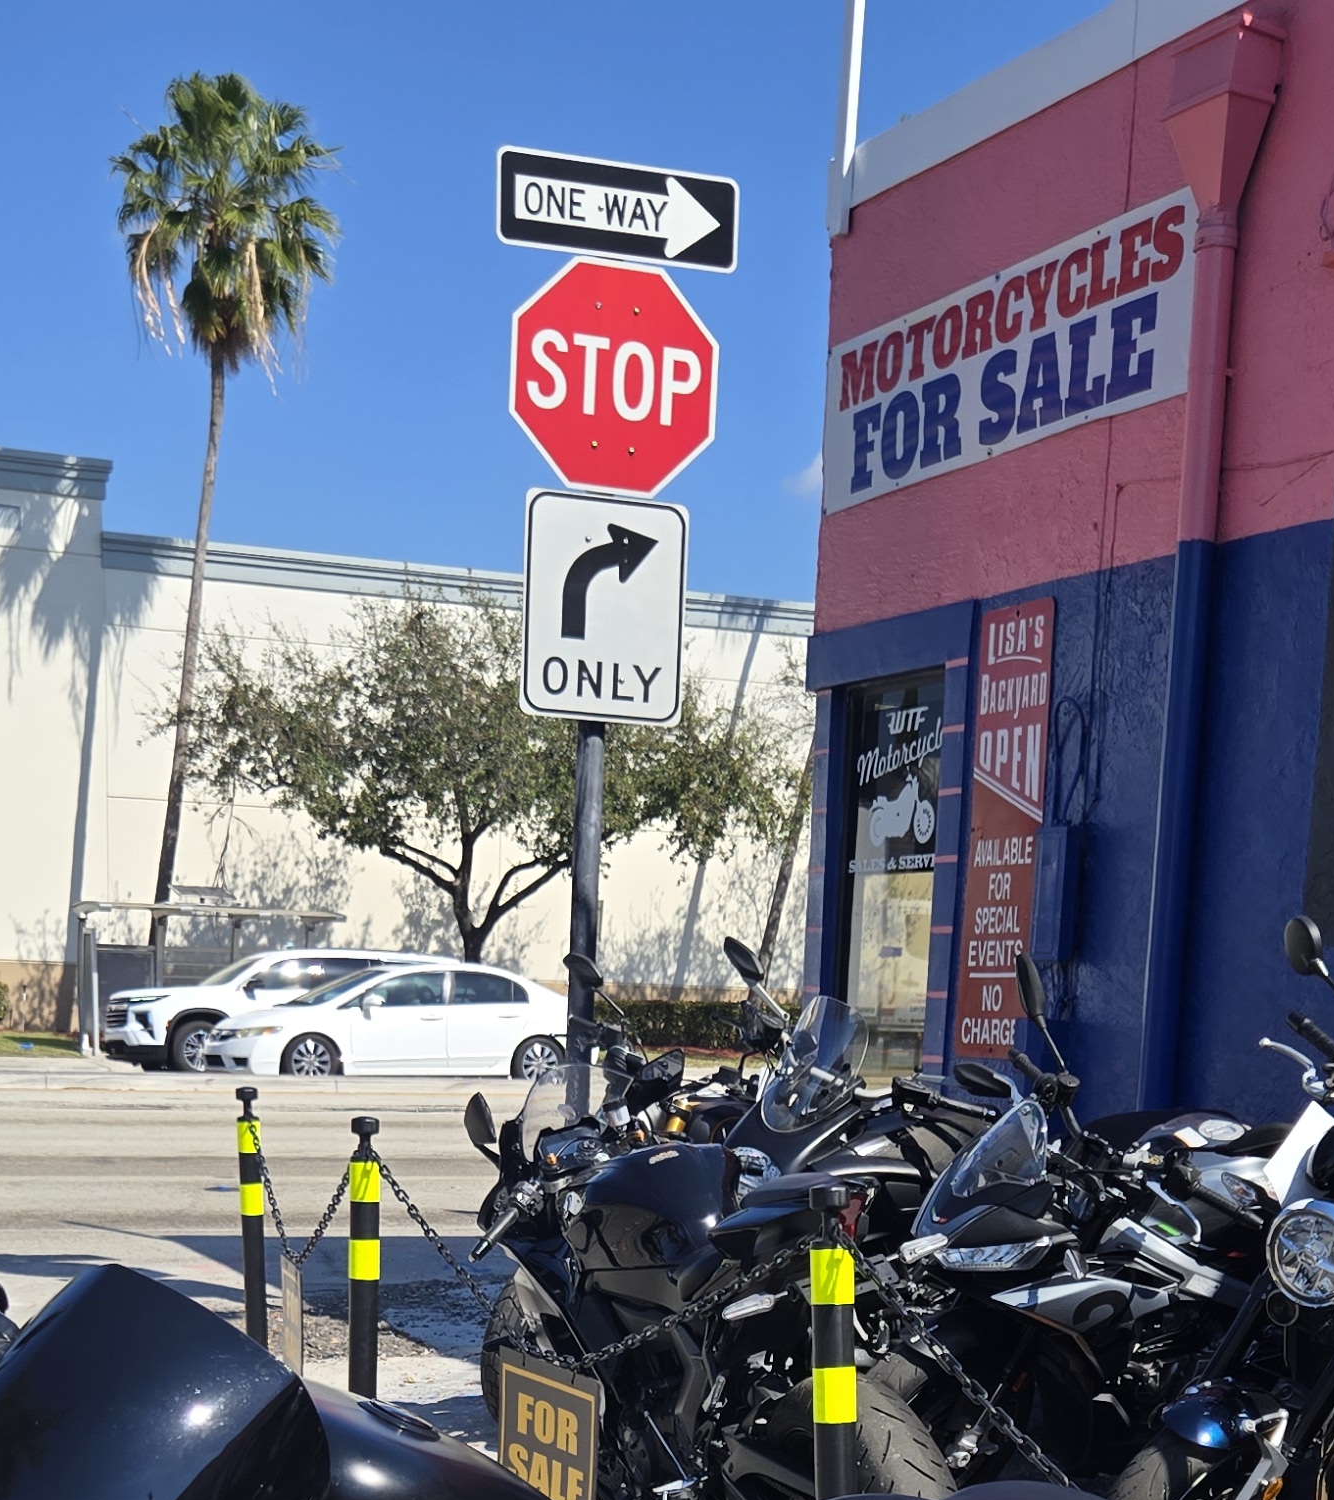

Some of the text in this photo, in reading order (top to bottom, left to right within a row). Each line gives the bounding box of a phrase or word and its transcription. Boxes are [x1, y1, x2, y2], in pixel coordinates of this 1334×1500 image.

[522, 181, 668, 233] ONE WAY
[839, 204, 1185, 413] MOTORCYCLES
[525, 327, 703, 427] STOP
[851, 291, 1159, 494] FOR SALE
[987, 615, 1045, 666] LISA'S
[541, 655, 663, 704] ONLY
[980, 671, 1048, 720] BACKYARD
[886, 705, 929, 735] WTF
[856, 716, 943, 787] Motorcycl
[979, 722, 1042, 803] OPEN
[848, 858, 886, 874] SALES
[887, 856, 897, 871] &
[973, 836, 1034, 868] AVAILABLE
[988, 872, 1012, 900] FOR
[974, 906, 1020, 935] SPECIAL
[981, 984, 1003, 1012] NO
[517, 1392, 578, 1456] FOR
